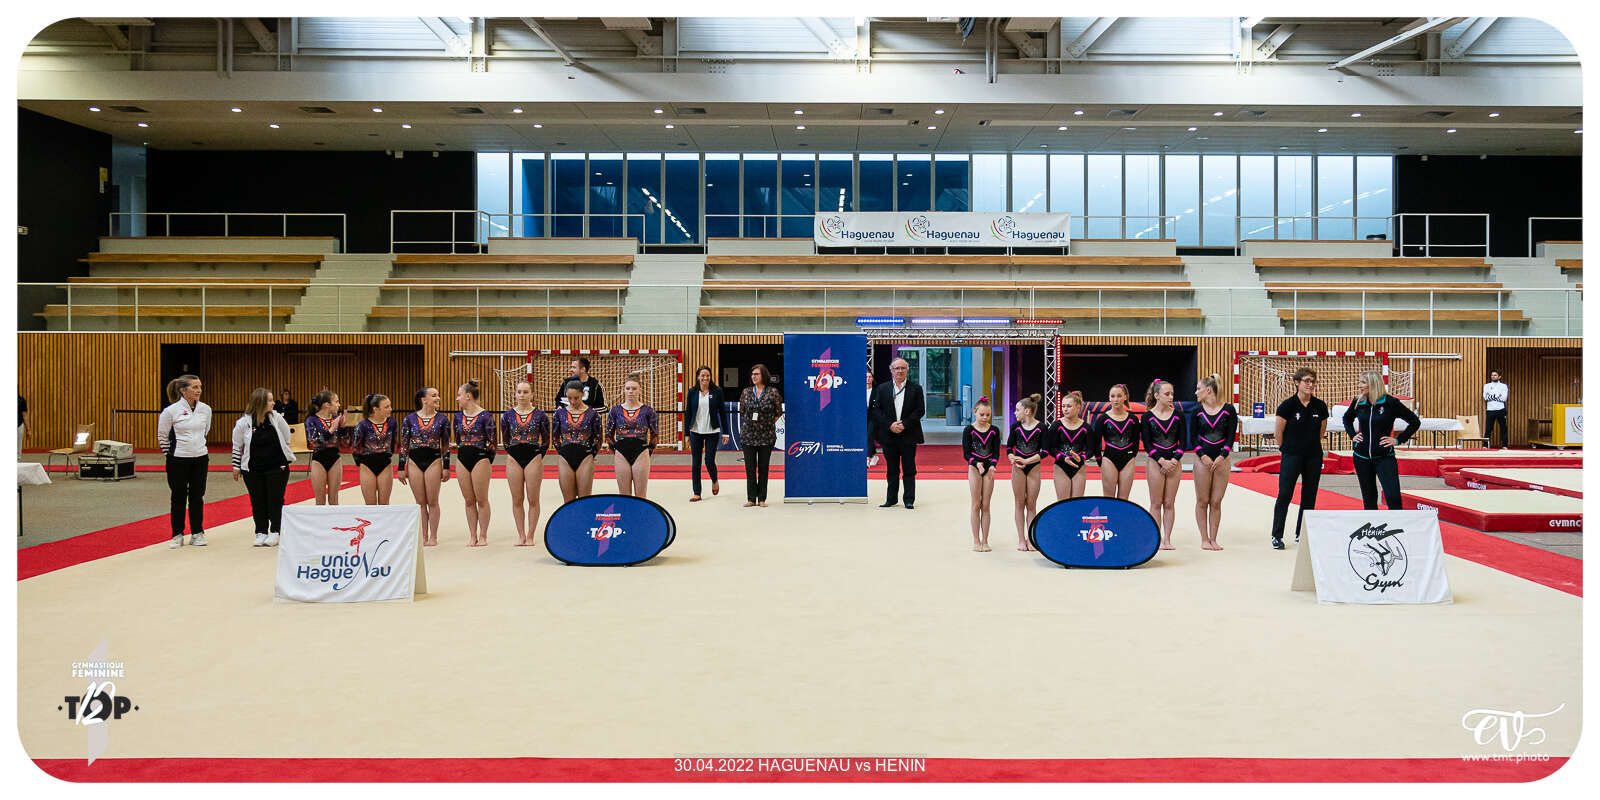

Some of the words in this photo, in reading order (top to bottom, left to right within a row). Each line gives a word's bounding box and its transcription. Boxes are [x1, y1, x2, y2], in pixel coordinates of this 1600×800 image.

[841, 230, 895, 240] Haguenau
[926, 230, 980, 240] Haguenau
[1012, 230, 1065, 240] Haguenau
[1363, 573, 1404, 593] Gym
